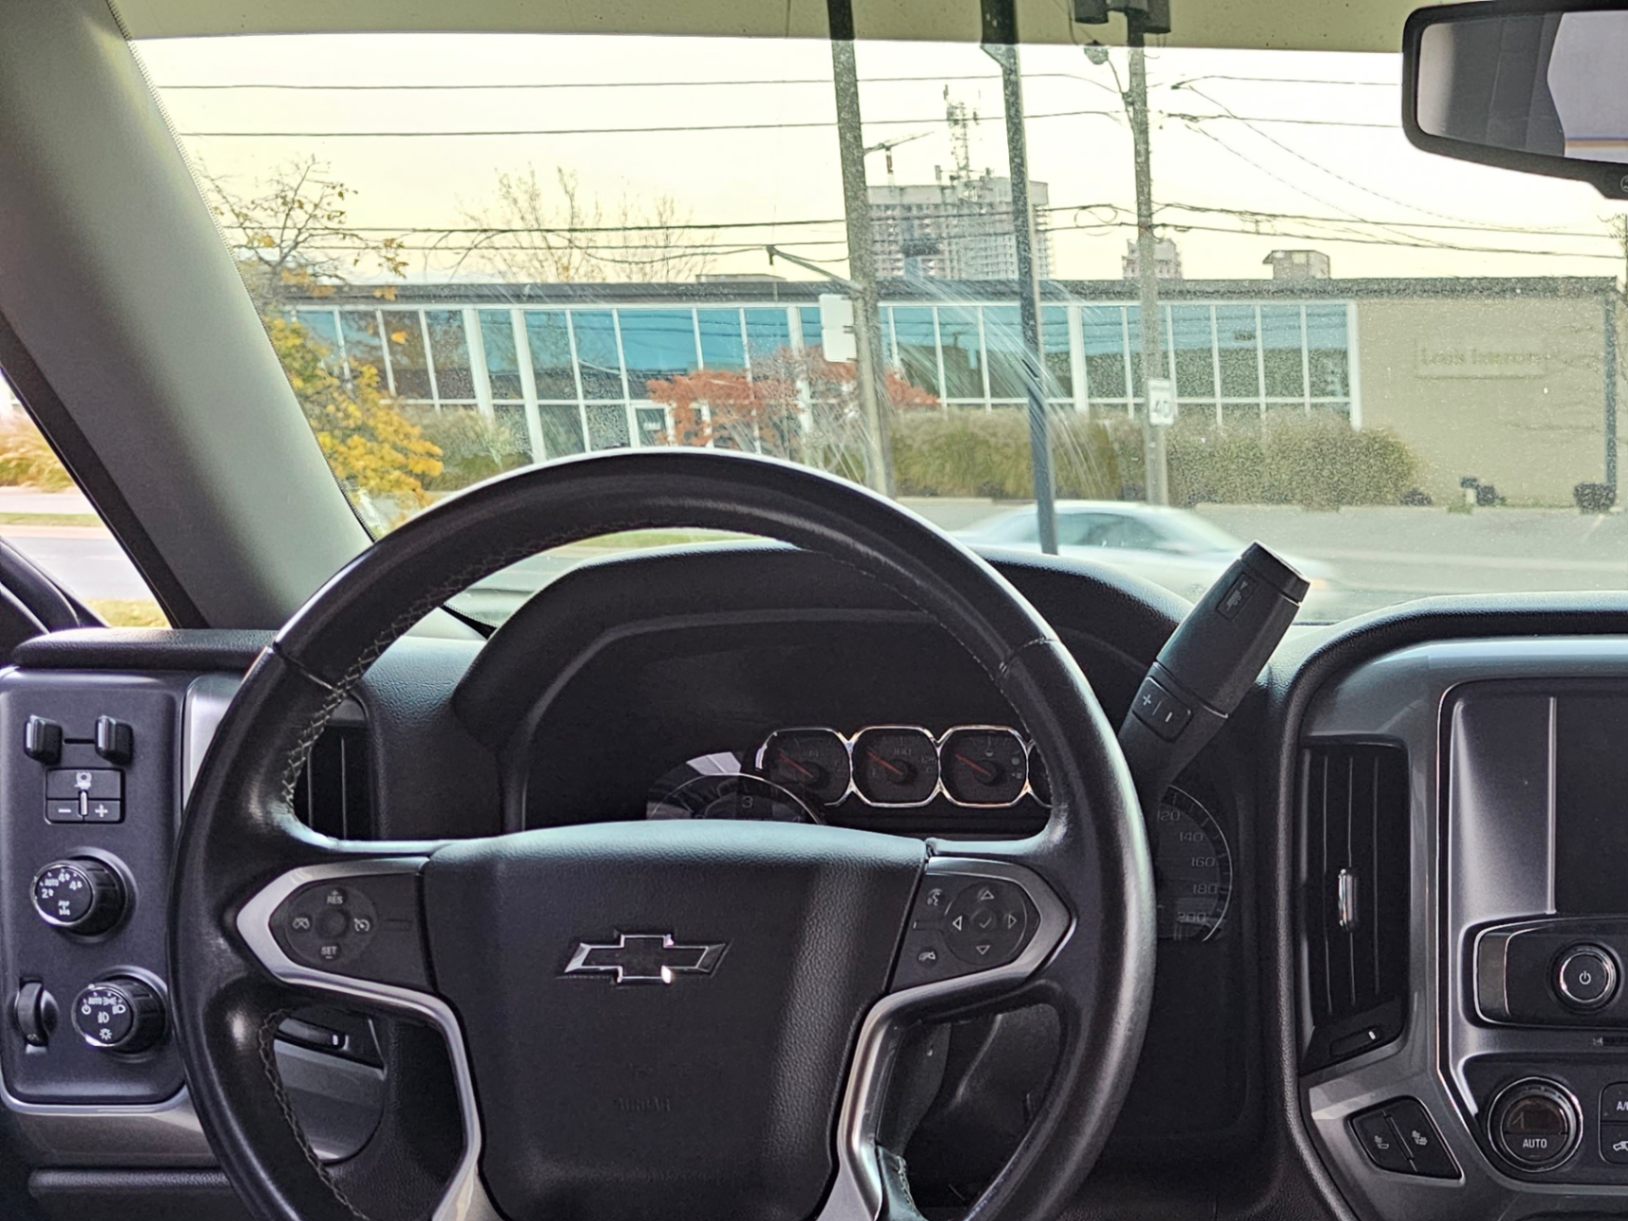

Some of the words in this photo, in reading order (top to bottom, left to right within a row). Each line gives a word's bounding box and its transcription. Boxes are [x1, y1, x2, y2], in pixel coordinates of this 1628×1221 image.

[1179, 831, 1205, 843] 140
[1191, 856, 1216, 868] 160
[1192, 884, 1218, 896] 180
[326, 895, 344, 905] RES
[321, 945, 338, 956] SET
[1522, 1138, 1548, 1149] AUTO
